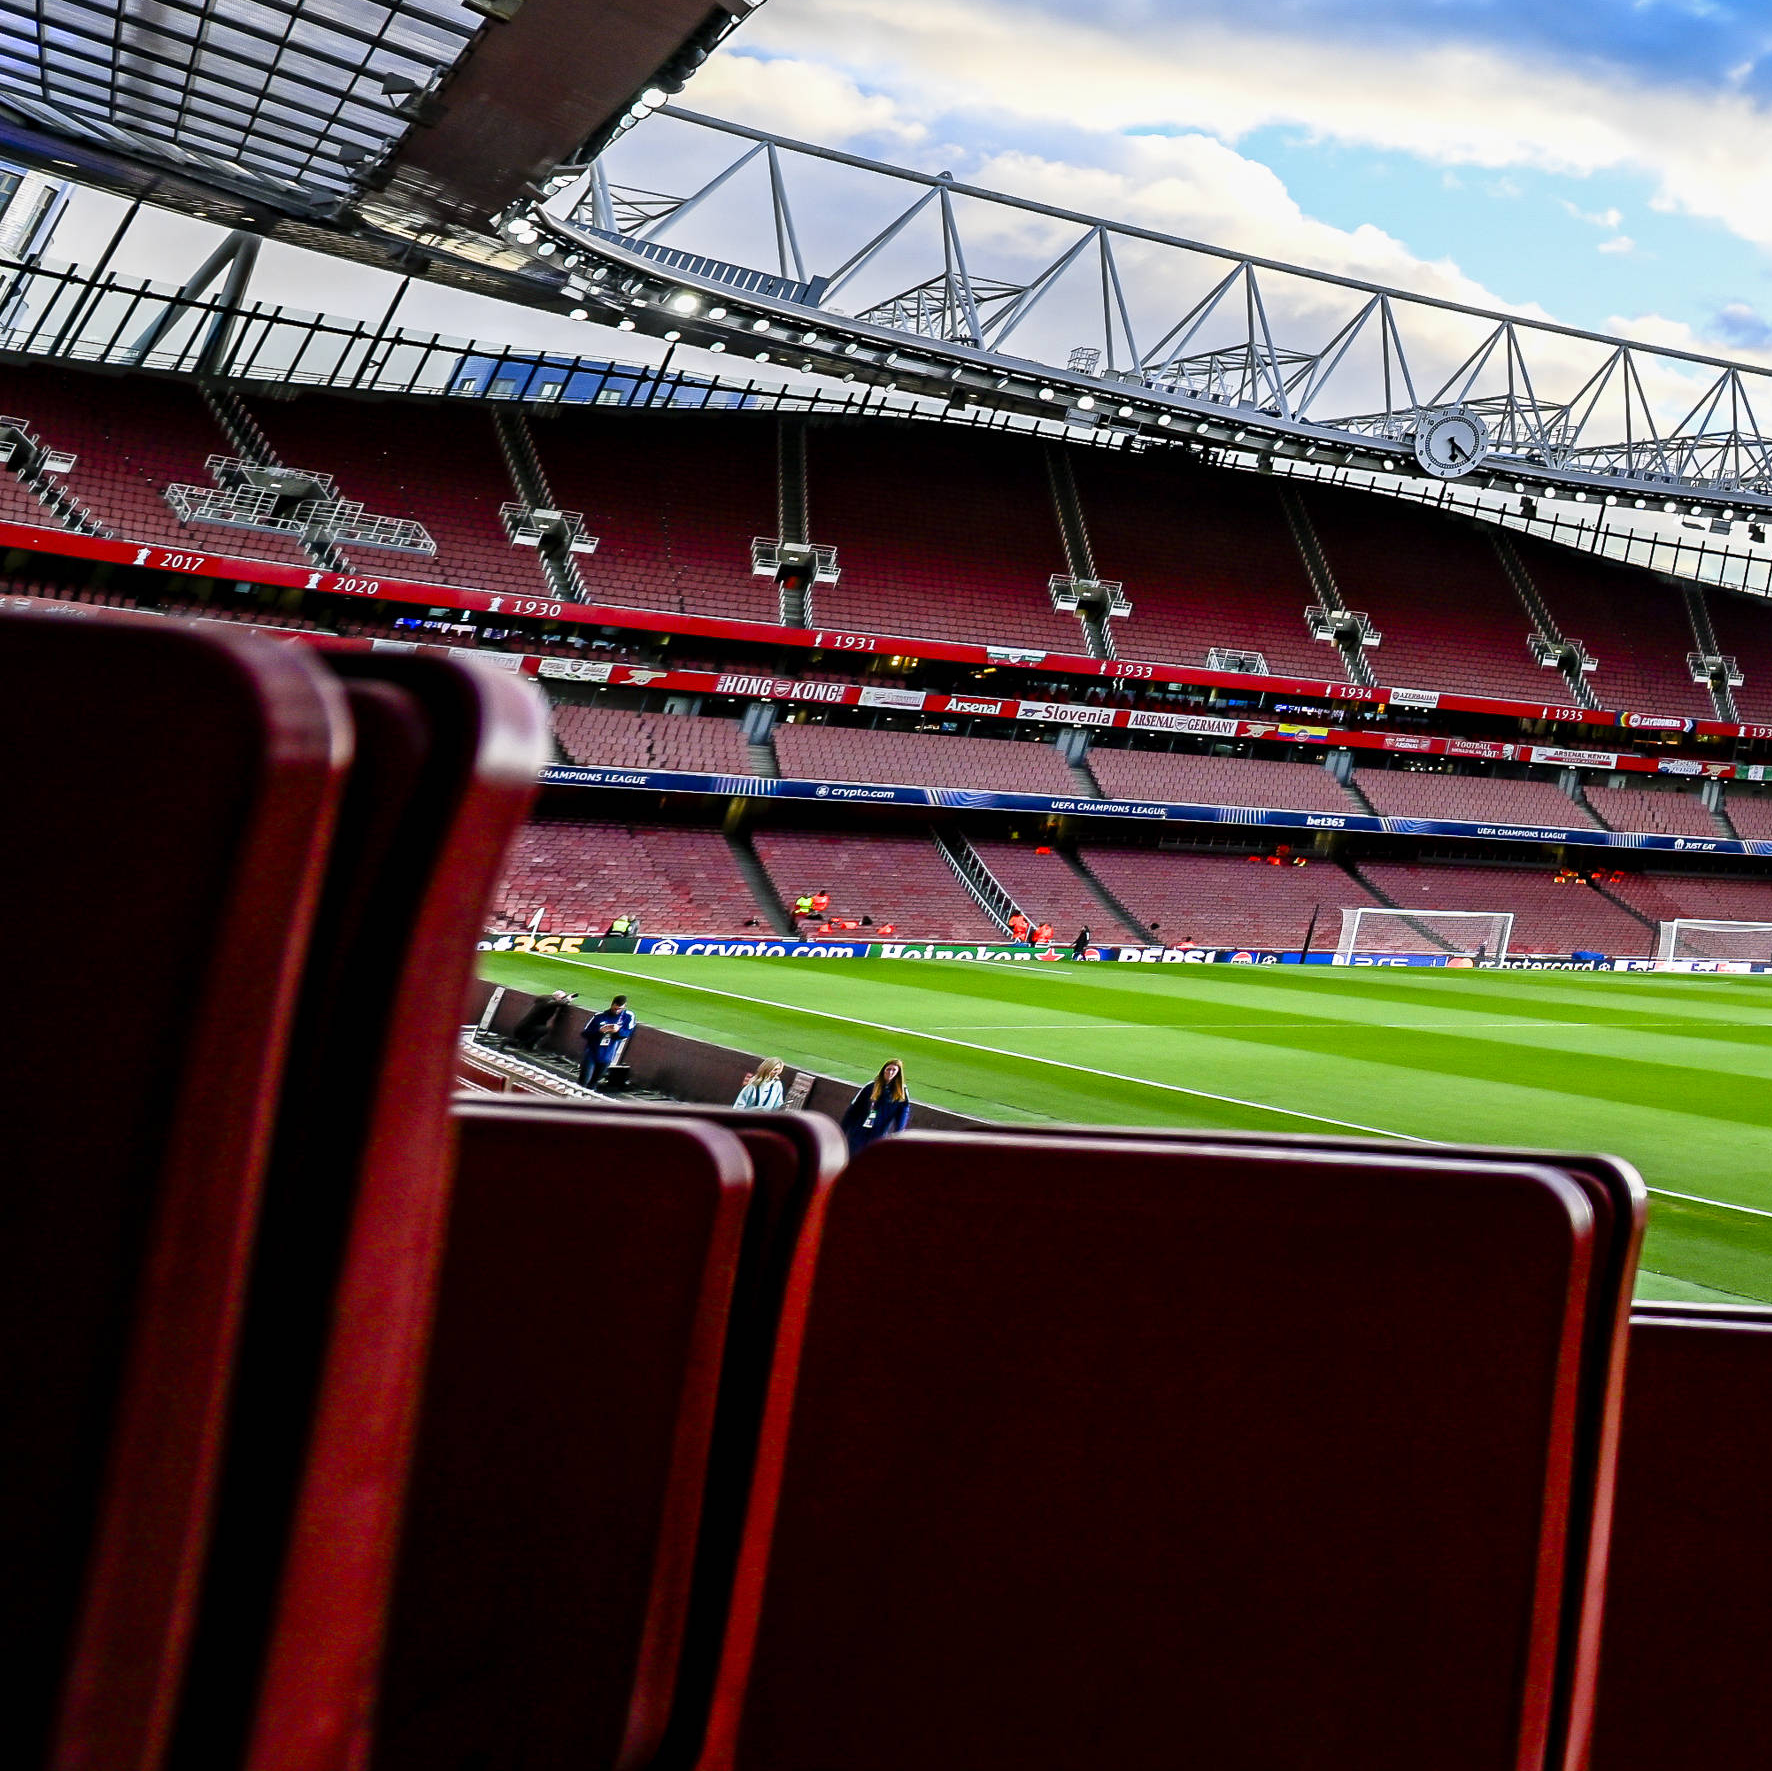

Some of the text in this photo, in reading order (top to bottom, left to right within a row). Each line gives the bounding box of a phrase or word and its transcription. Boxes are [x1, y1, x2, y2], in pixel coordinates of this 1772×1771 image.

[160, 553, 205, 571] 2017
[333, 577, 379, 595] 2020
[512, 600, 562, 617] 1930
[833, 635, 876, 651] 1931
[1115, 664, 1153, 678] 1933
[723, 676, 774, 696] HONG
[791, 682, 838, 702] KONG
[1339, 687, 1372, 700] 1934
[944, 697, 1002, 715] Arsenal
[1042, 705, 1111, 724] Slovenia
[1555, 709, 1584, 721] 1935
[1131, 714, 1236, 734] ARSENAL GERMANY
[1554, 750, 1586, 759] ARSENAL
[1587, 753, 1611, 761] KENYA
[538, 769, 647, 785] CHAMPIONS LEAGUE
[831, 787, 895, 799] crypto.com
[1051, 801, 1167, 816] UEFA CHAMPIONS LEAGUE
[1306, 816, 1346, 828] bet365
[1497, 829, 1539, 838] CHAMPIONS
[1540, 832, 1567, 840] LEAGUE
[1685, 842, 1701, 850] JUST
[880, 942, 1041, 961] Heineken
[1118, 948, 1217, 963] PEPSI
